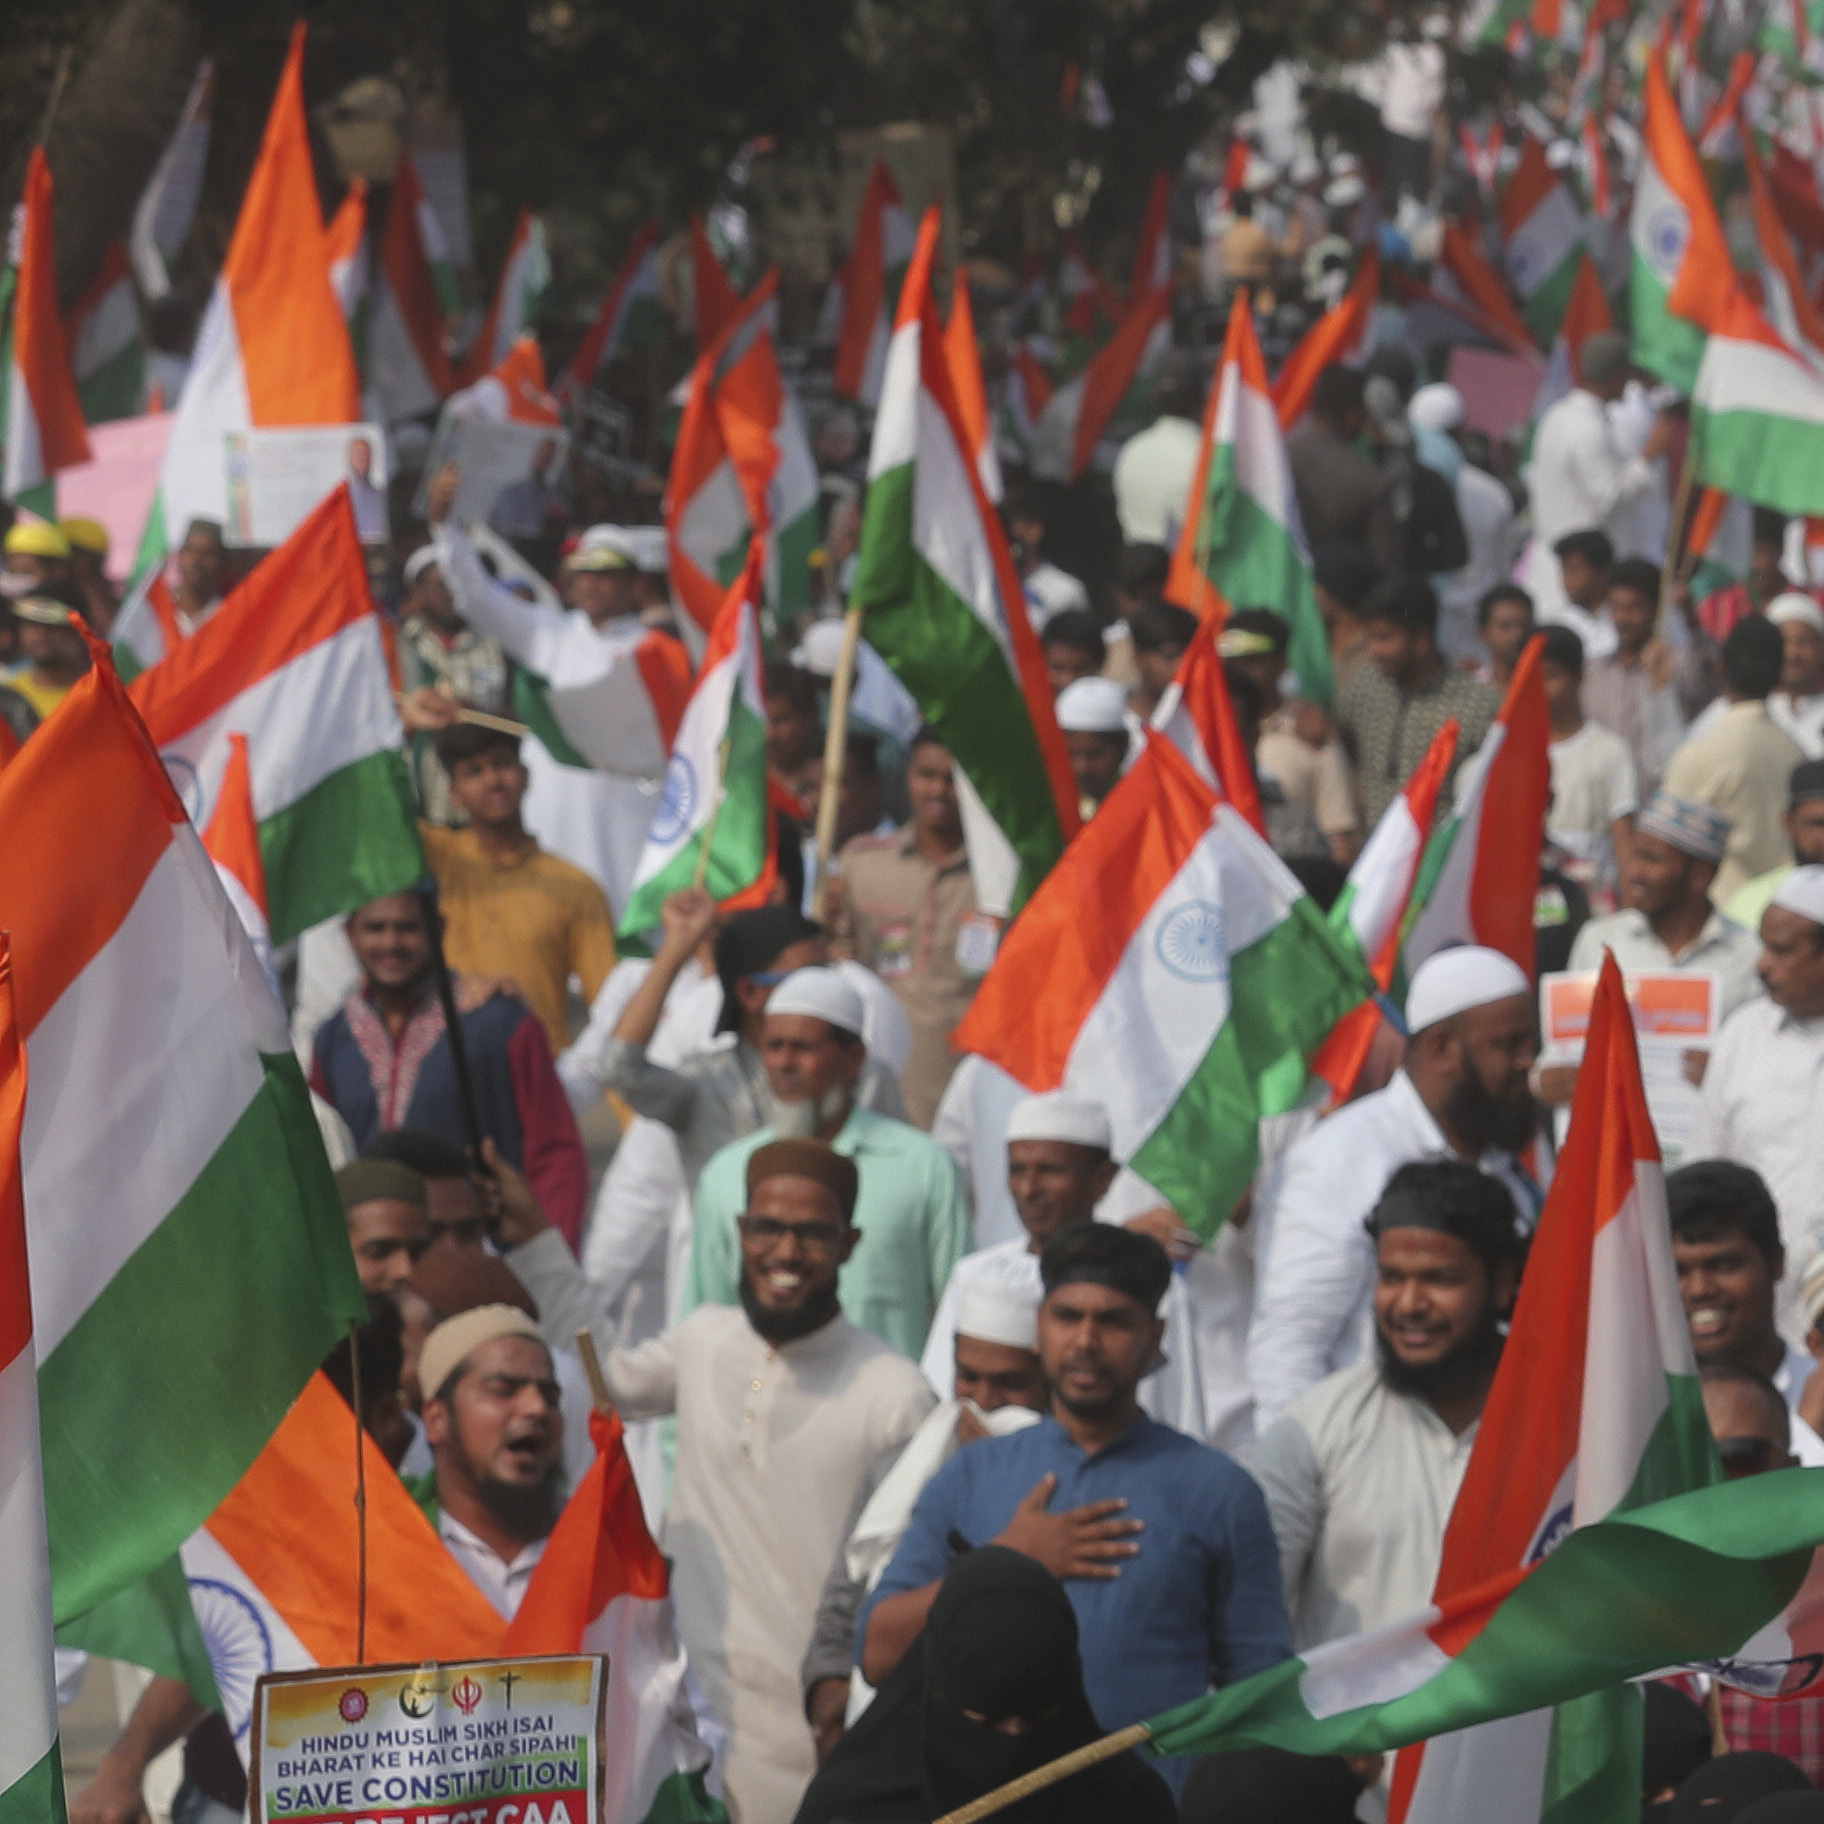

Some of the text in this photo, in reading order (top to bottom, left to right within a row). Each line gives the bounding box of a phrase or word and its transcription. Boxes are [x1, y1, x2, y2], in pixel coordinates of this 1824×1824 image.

[278, 1734, 577, 1778] BHARAT KE HAI CHAR SIPAHI
[302, 1715, 553, 1754] HINDU MUSLIM SIKH ISAI
[276, 1760, 579, 1812] SAVE CONSTITUTION
